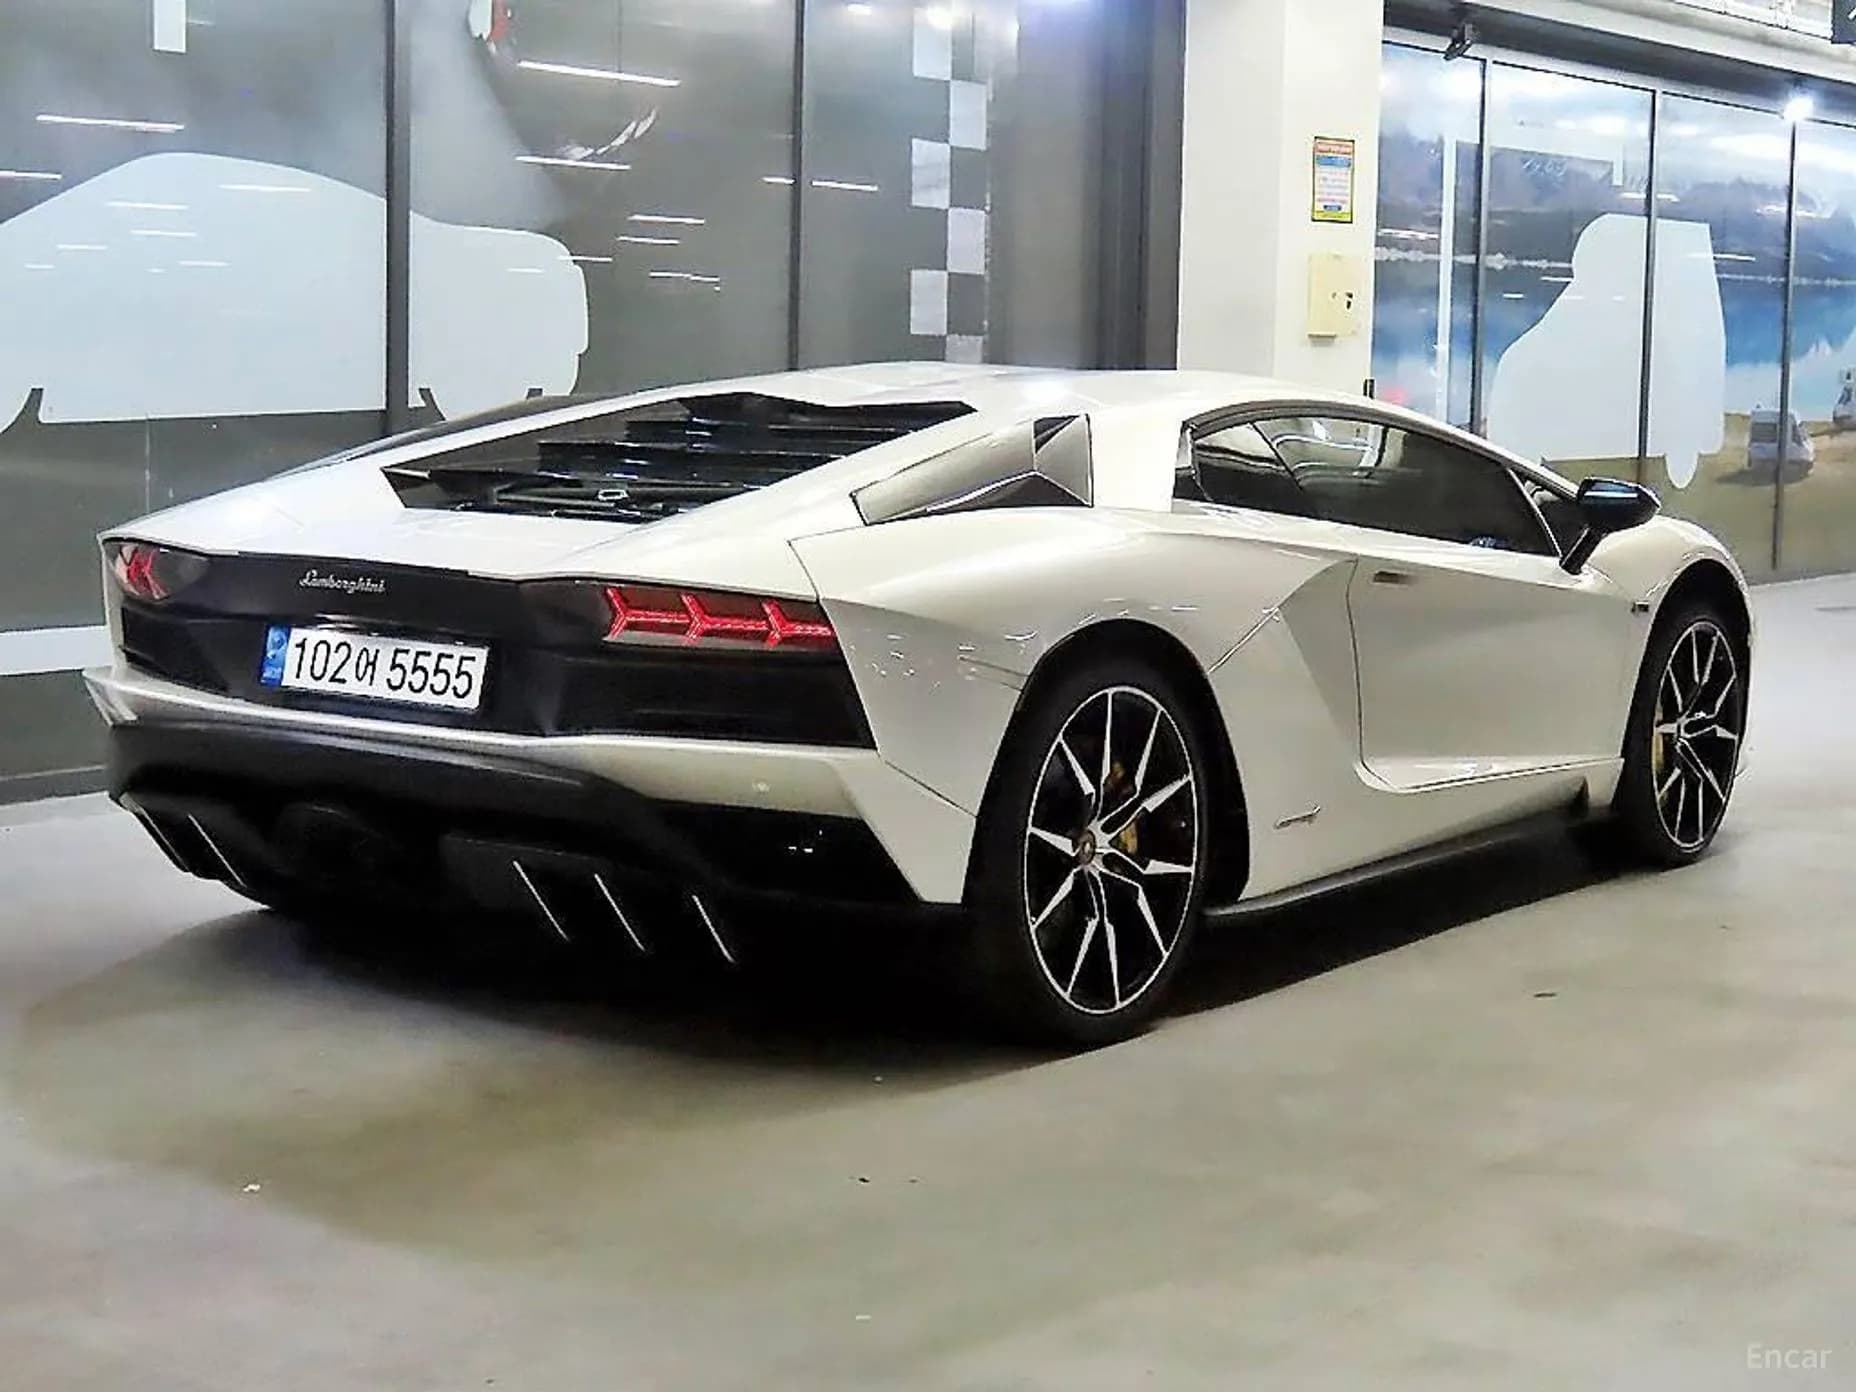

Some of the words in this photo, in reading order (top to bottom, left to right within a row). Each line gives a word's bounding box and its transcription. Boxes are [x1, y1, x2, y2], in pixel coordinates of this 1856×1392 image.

[299, 569, 386, 594] Lamborghini
[295, 637, 380, 686] 102어
[386, 648, 477, 699] 5555
